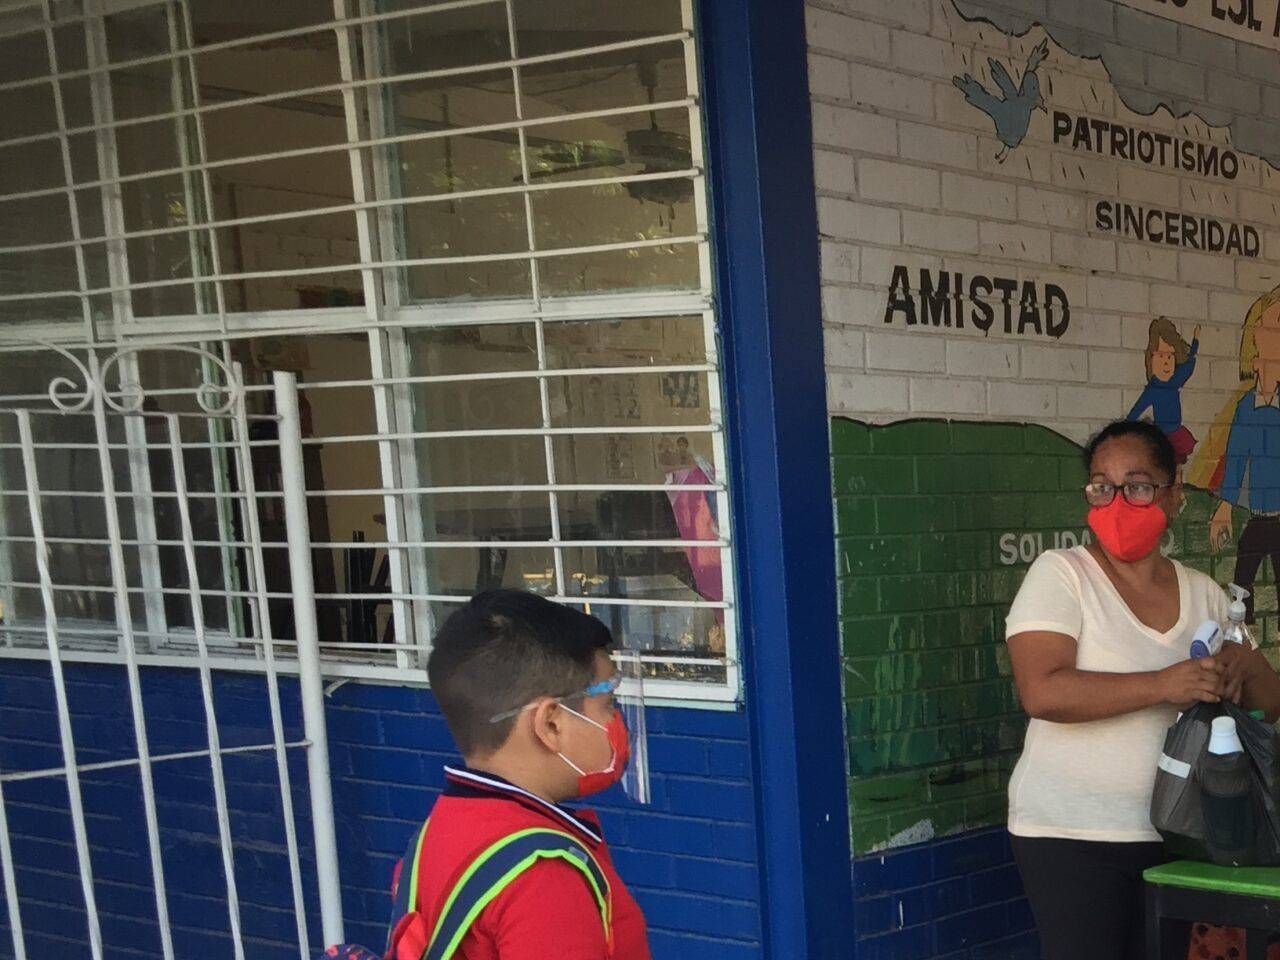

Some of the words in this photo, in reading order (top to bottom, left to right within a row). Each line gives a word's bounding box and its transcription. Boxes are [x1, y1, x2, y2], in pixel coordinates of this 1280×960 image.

[1053, 111, 1239, 180] PATRIOTISMO
[1095, 201, 1260, 258] SINCERIDAD
[883, 265, 1071, 338] AMISTAD
